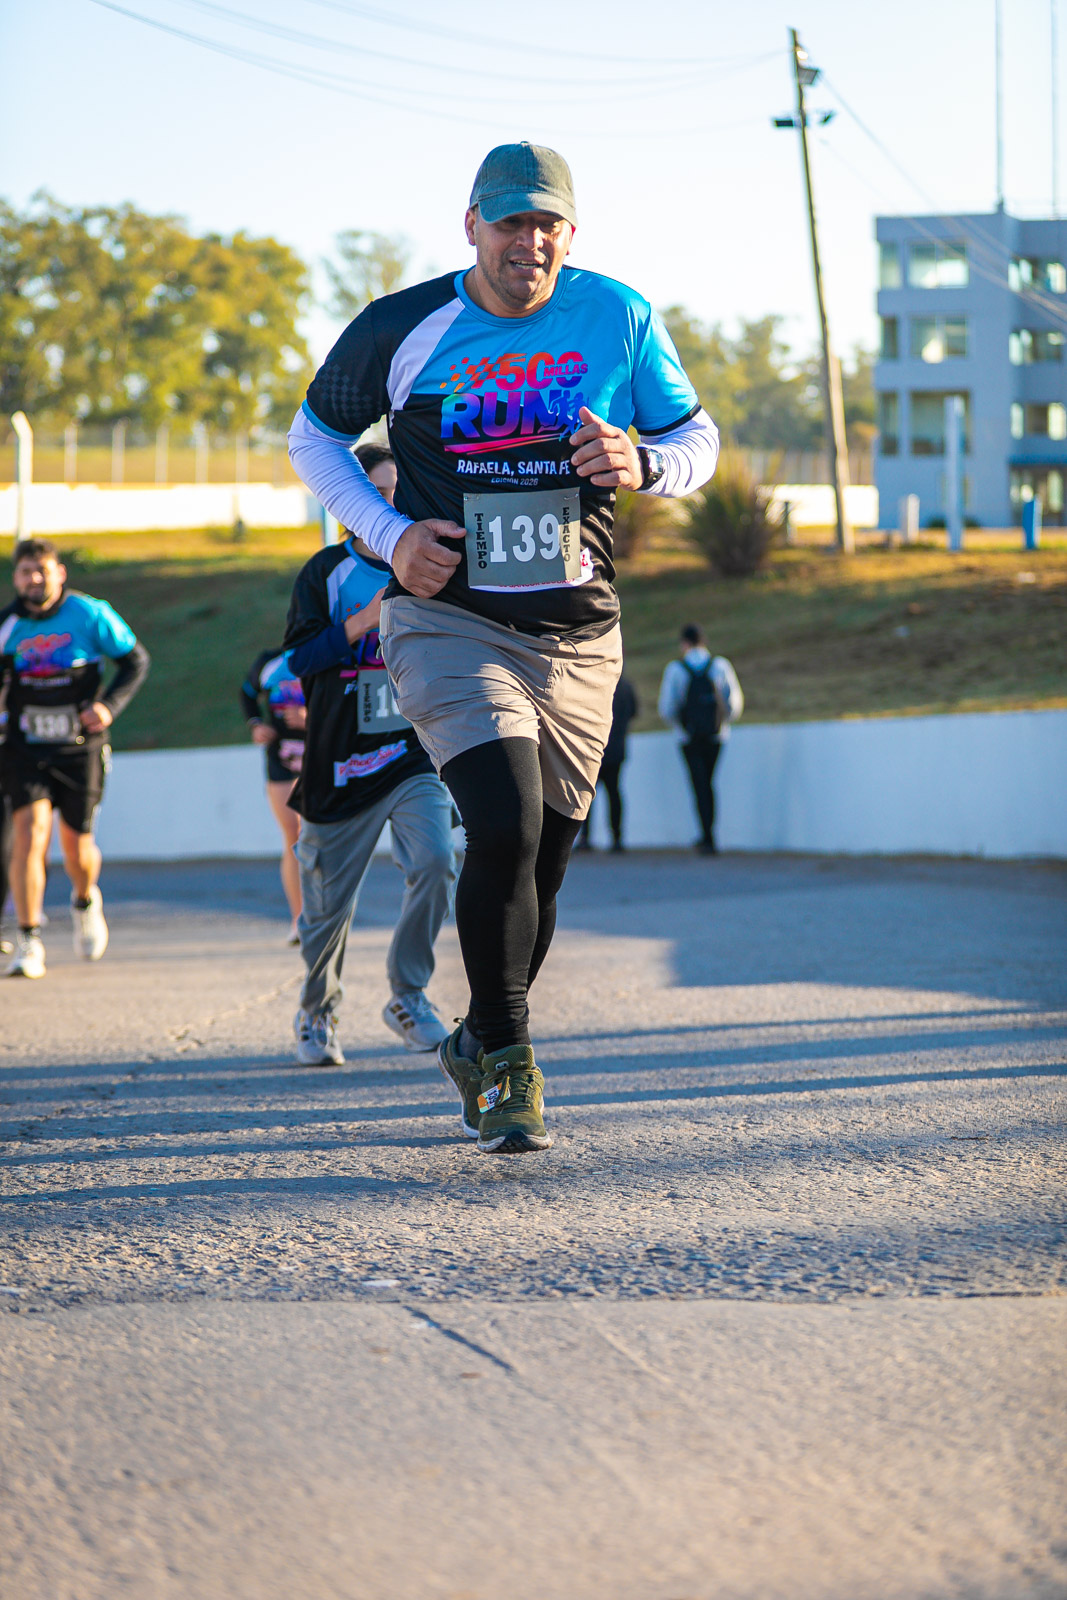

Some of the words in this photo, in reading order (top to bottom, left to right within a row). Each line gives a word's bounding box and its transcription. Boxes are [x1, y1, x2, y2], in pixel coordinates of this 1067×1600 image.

[543, 363, 588, 377] MILLAS
[440, 390, 572, 439] RUN
[456, 459, 515, 476] RAFAELA,
[518, 460, 557, 475] SANTA
[559, 459, 570, 475] FE
[475, 513, 487, 569] TIEMPO
[488, 513, 561, 563] 139
[562, 507, 570, 562] EXACTO
[363, 683, 371, 723] TIEMPO
